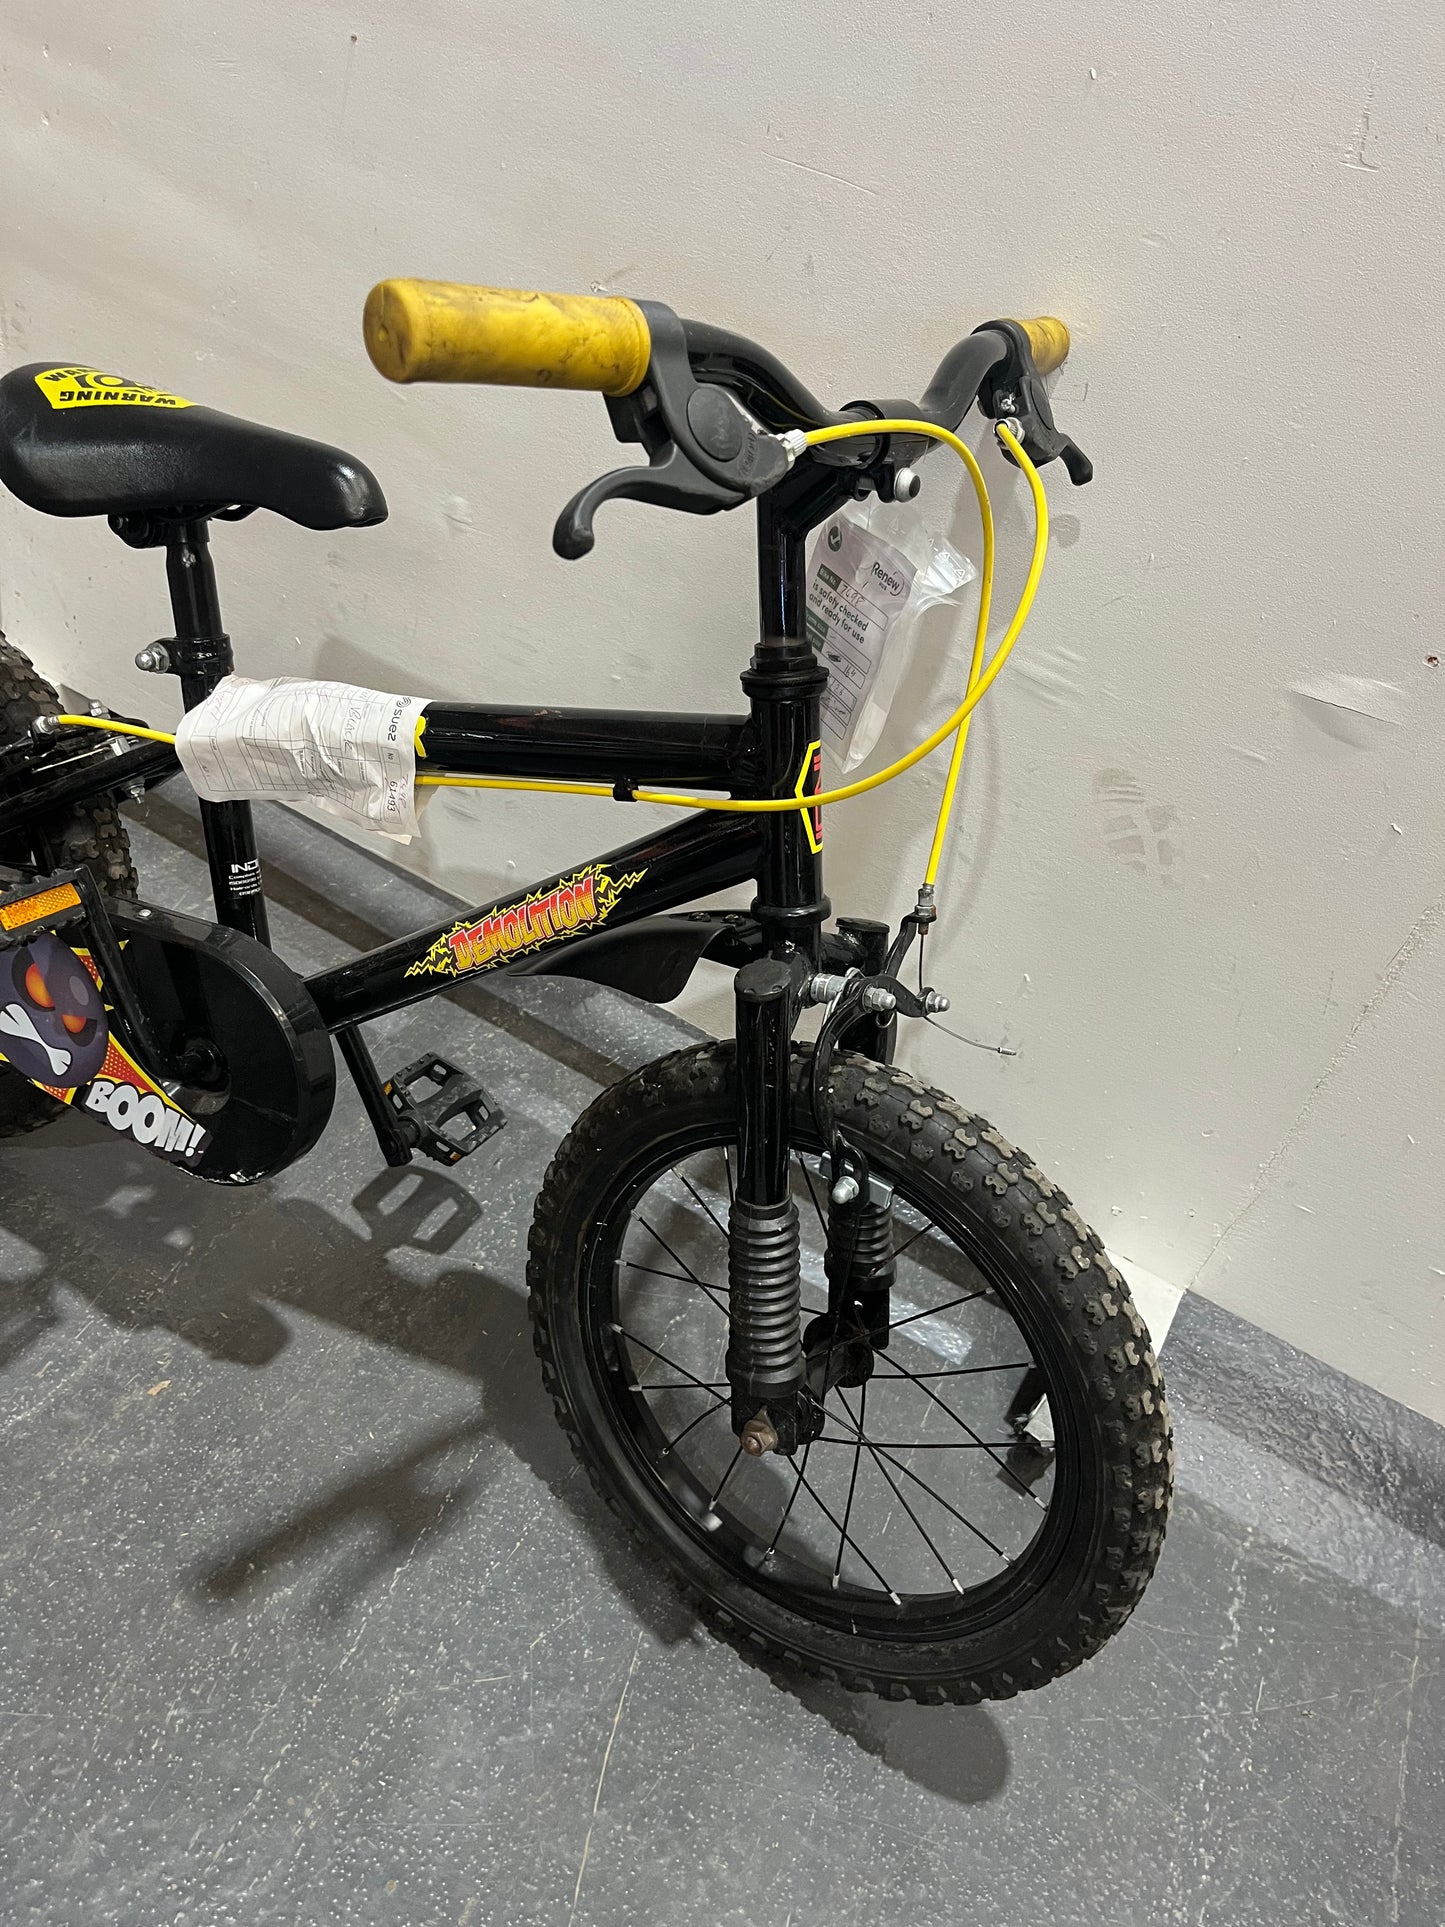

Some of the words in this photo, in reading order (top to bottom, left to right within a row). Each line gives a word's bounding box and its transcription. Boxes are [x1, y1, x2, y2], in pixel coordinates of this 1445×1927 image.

[59, 391, 176, 405] WARNING
[871, 561, 900, 592] Renew
[809, 593, 823, 608] and
[822, 604, 840, 627] ready
[841, 618, 852, 633] for
[852, 629, 865, 644] use
[813, 579, 819, 591] is
[819, 587, 840, 610] safety
[839, 604, 869, 632] checked
[448, 875, 597, 971] DEMOLITION
[84, 1080, 207, 1157] BOOM!
